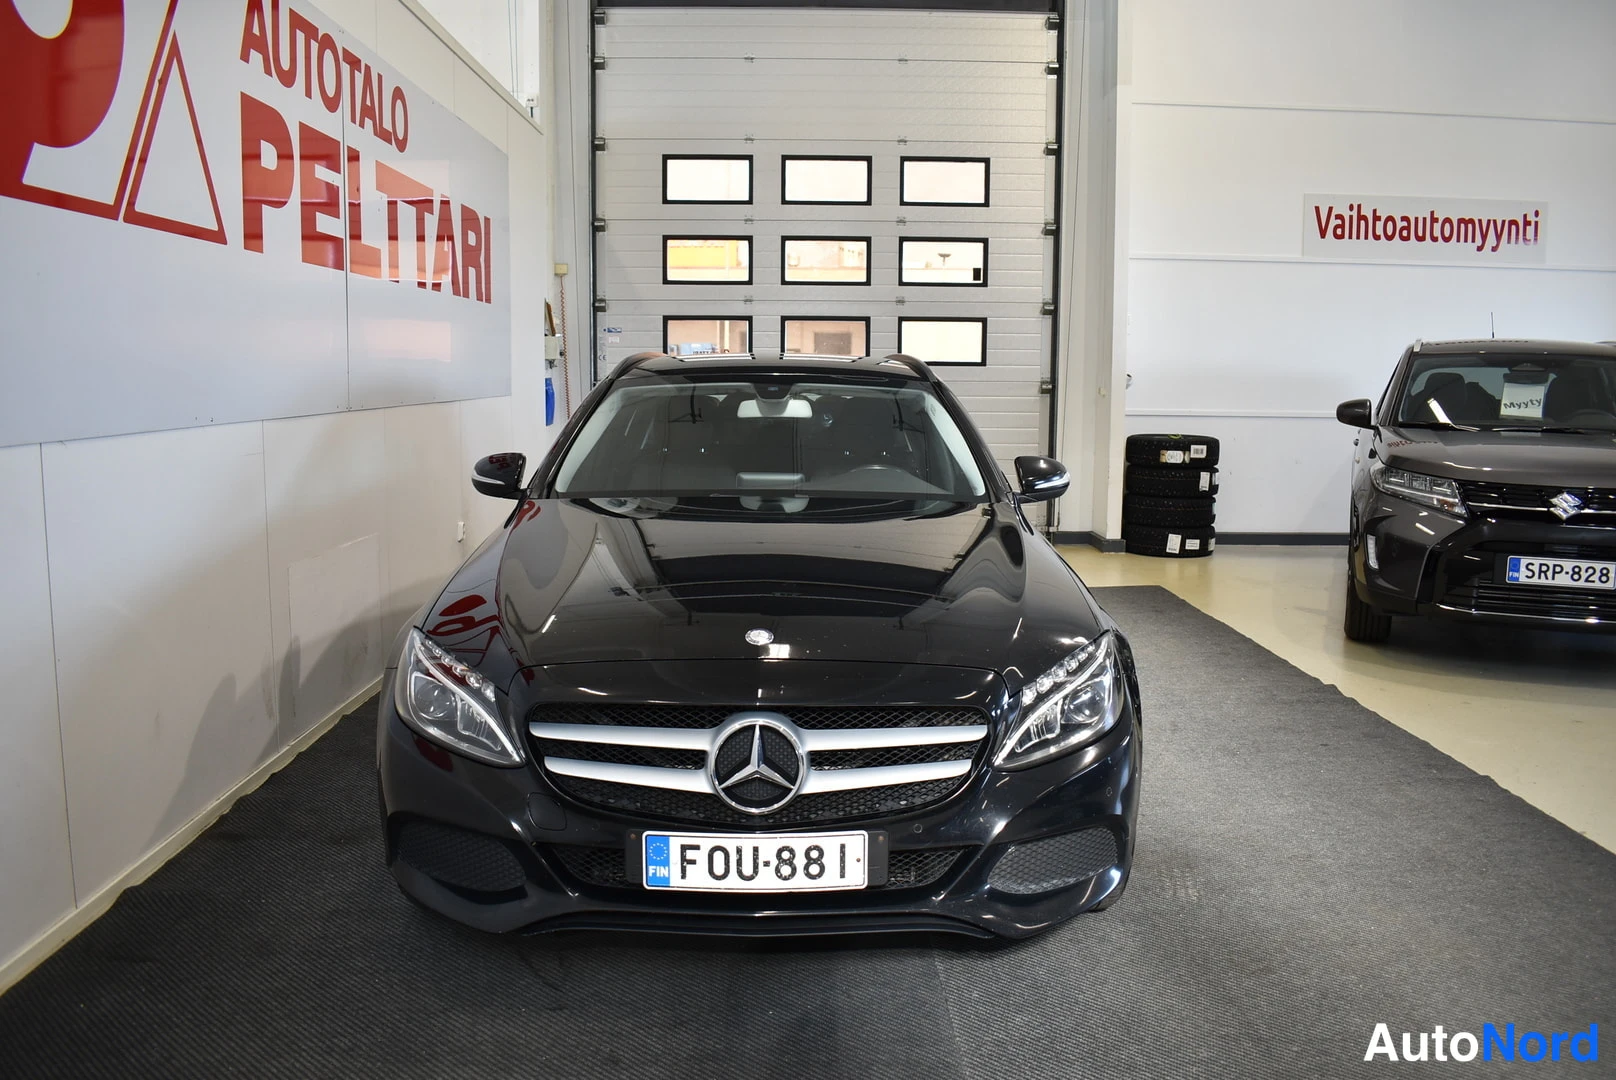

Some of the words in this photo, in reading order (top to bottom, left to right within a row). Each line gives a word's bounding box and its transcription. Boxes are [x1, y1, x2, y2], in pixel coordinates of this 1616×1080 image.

[239, 0, 409, 153] AUTOTALO
[240, 91, 492, 304] PELTTARI
[1314, 203, 1540, 252] Vaihtoautomyynti
[1503, 398, 1542, 409] Myyty
[1525, 562, 1611, 584] SRP-828
[648, 865, 669, 877] FIN
[680, 843, 846, 881] FOU-881
